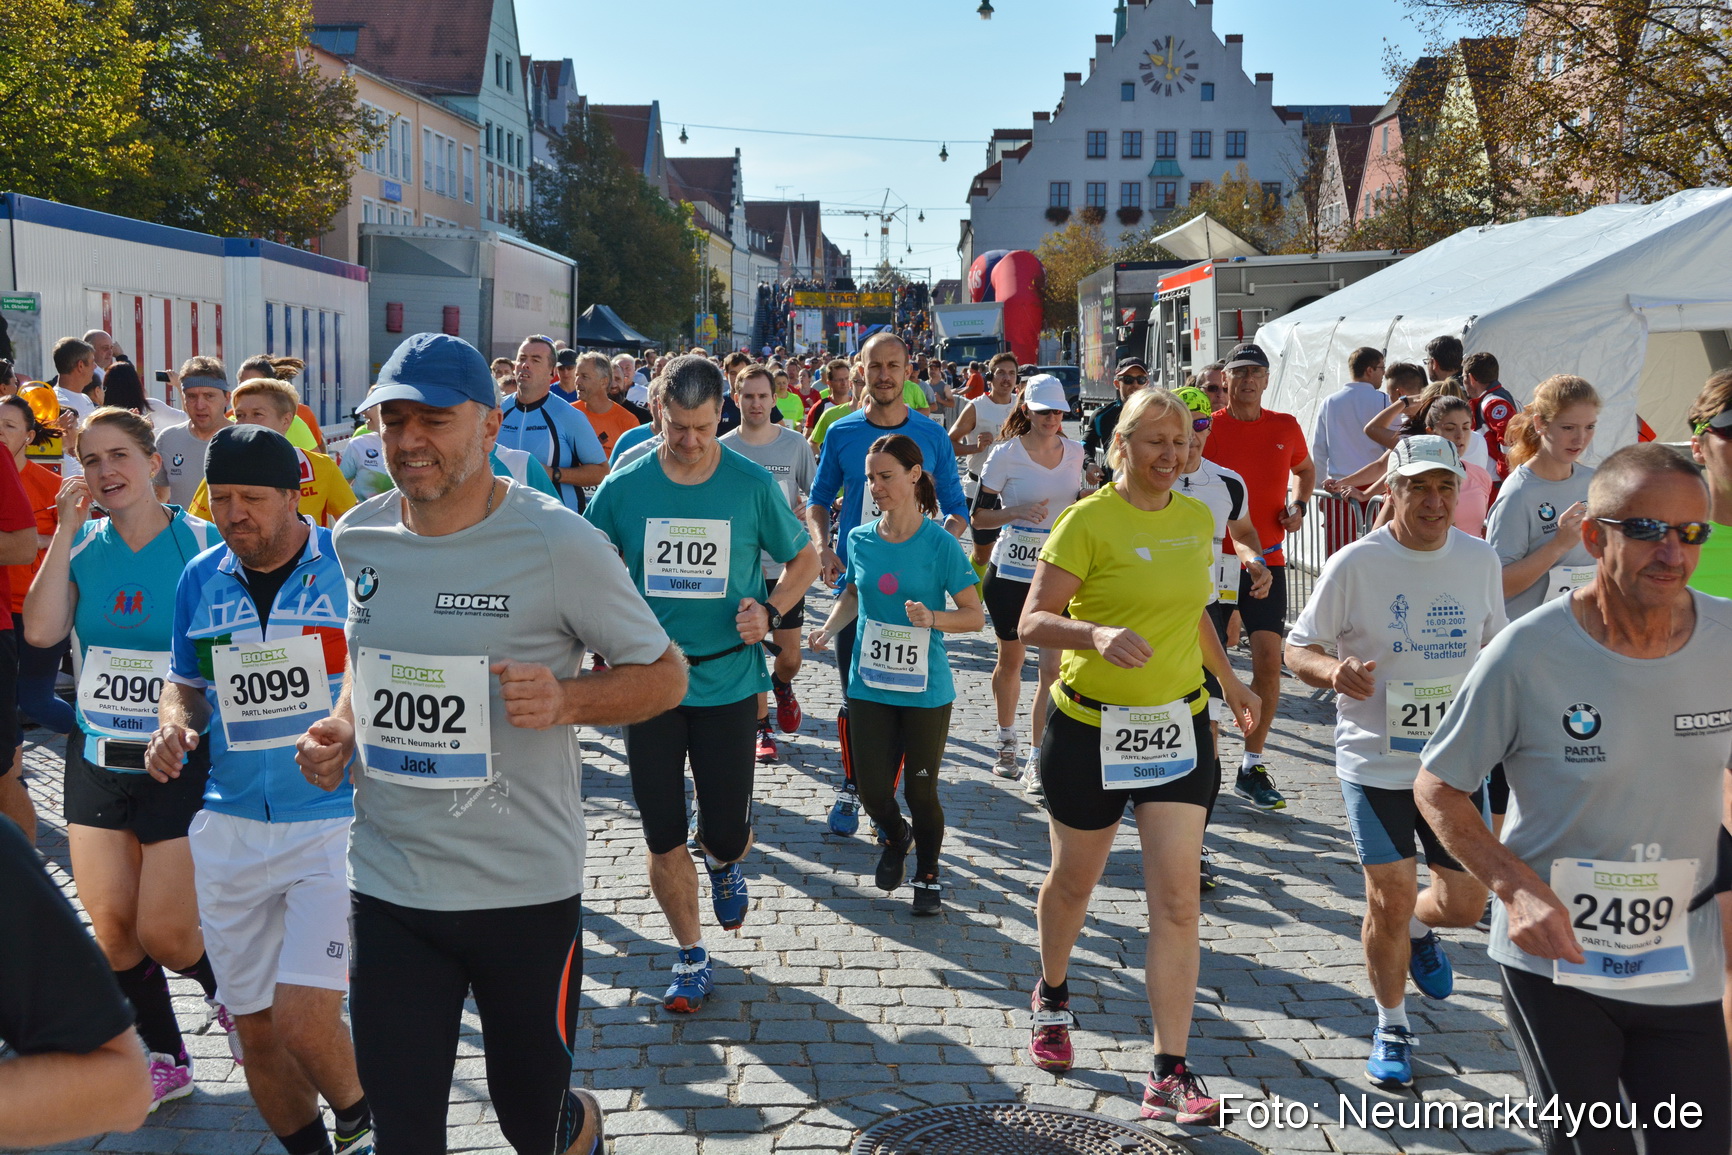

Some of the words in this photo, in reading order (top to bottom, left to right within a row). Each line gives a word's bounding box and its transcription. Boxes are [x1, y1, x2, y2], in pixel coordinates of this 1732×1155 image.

[826, 294, 860, 304] START
[670, 526, 706, 535] BOCK
[657, 541, 717, 566] 2102
[670, 579, 702, 590] Volker
[436, 593, 510, 611] BOCK
[208, 592, 338, 629] ITALIA
[1426, 618, 1466, 626] 16.09.2007
[881, 629, 911, 639] BOCK
[870, 640, 918, 665] 3115
[1393, 641, 1408, 653] 8.
[1411, 642, 1467, 652] Neumarkter
[241, 648, 288, 664] BOCK
[1424, 650, 1467, 660] Stadtlauf
[111, 657, 153, 669] BOCK
[392, 664, 445, 683] BOCK
[93, 673, 164, 703] 2090
[230, 667, 310, 706] 3099
[1414, 685, 1452, 696] BOCK
[99, 703, 119, 711] PARTL
[241, 708, 261, 717] PARTL
[262, 705, 297, 716] Neumarkt
[373, 689, 467, 734] 2092
[1401, 700, 1454, 728] 211
[113, 717, 143, 730] Kathi
[1130, 711, 1170, 722] BOCK
[1675, 709, 1732, 730] BOCK
[381, 735, 406, 746] PARTL
[407, 739, 447, 749] Neumarkt
[1115, 723, 1181, 752] 2542
[1565, 746, 1605, 756] PARTL
[400, 756, 438, 775] Jack
[1565, 755, 1606, 763] Neumarkt
[1134, 765, 1165, 778] Sonja
[1594, 872, 1659, 886] BOCK
[1573, 893, 1673, 935] 2489
[1582, 936, 1612, 948] PARTL
[1614, 940, 1653, 950] Neumarkt
[1602, 957, 1643, 975] Peter
